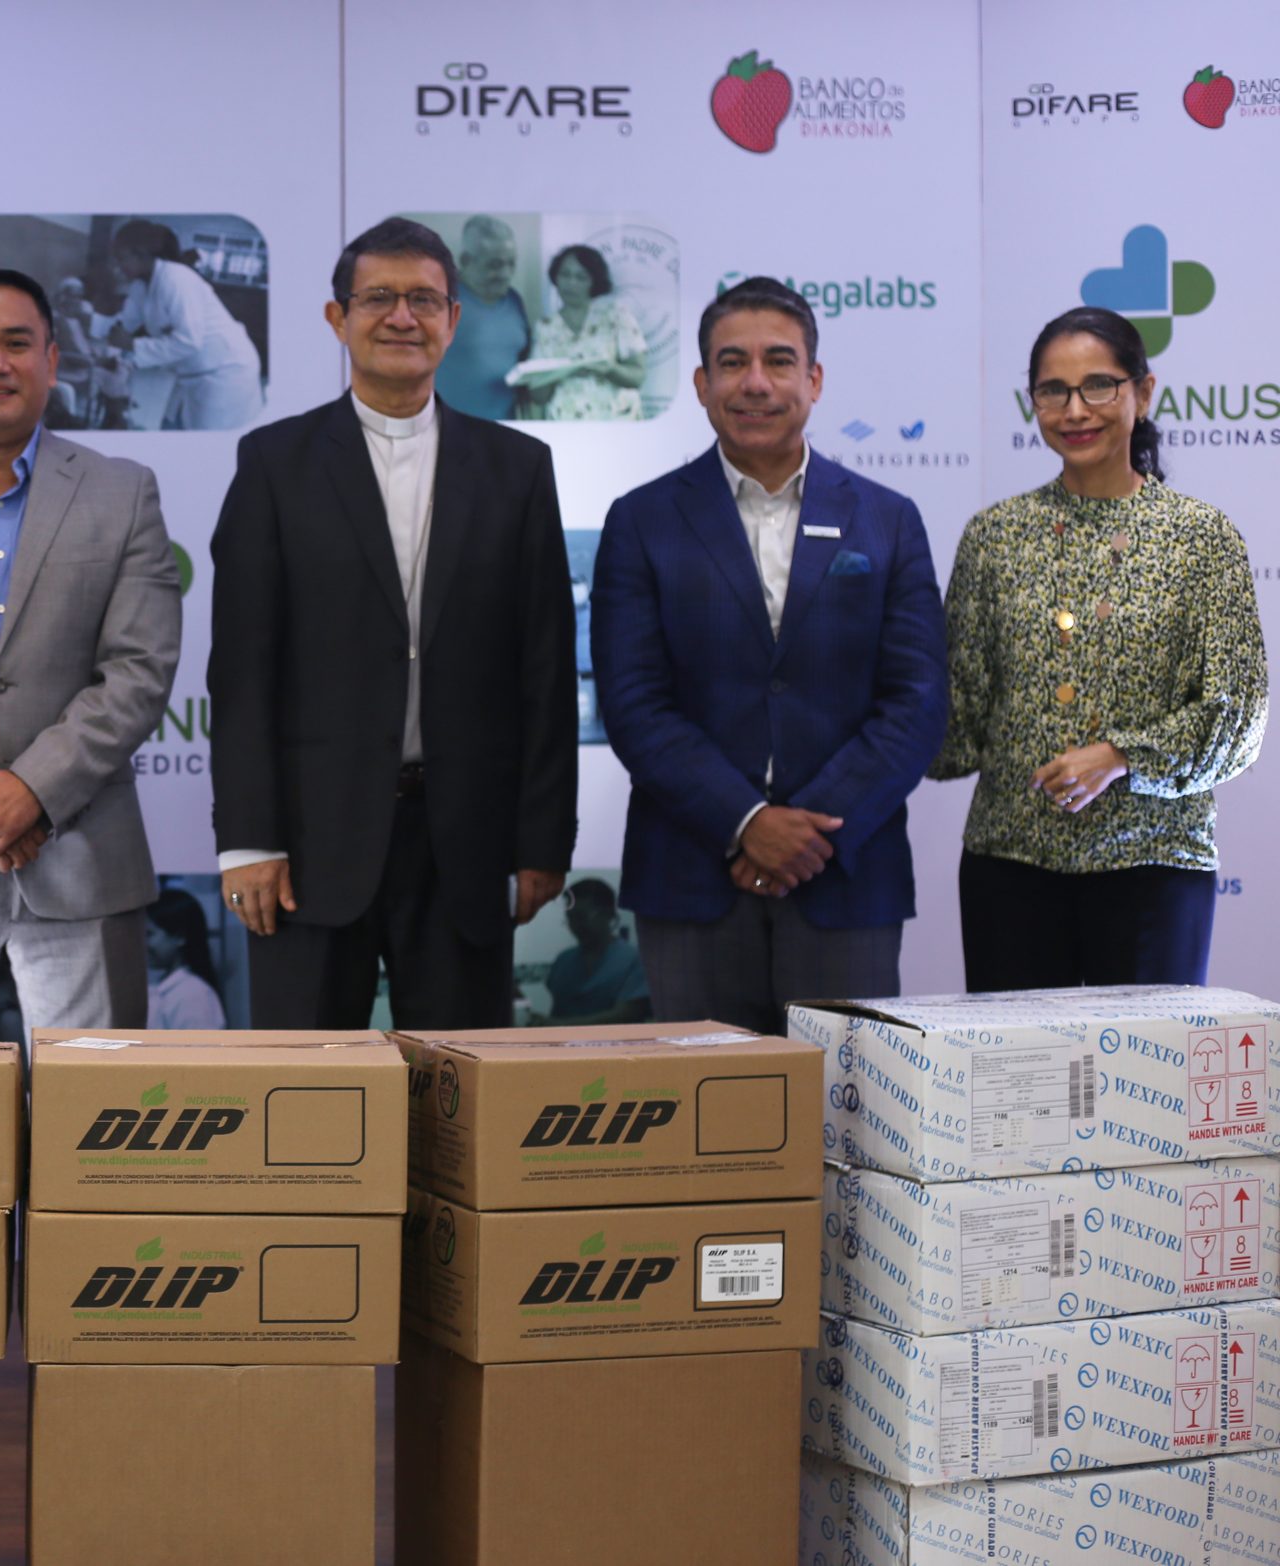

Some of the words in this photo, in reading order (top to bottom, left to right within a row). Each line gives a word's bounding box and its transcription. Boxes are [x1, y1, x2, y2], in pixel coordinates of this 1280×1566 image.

[799, 76, 886, 100] BANCO
[1235, 92, 1280, 107] ALIMEN
[1238, 79, 1280, 94] BANC
[416, 86, 631, 118] DIFARE
[793, 101, 906, 121] ALIMENTOS
[1012, 92, 1139, 117] DIFARE
[1240, 106, 1280, 117] DIAKO
[416, 122, 632, 137] GRUPO
[856, 453, 971, 468] SIEGFRIED
[869, 1019, 931, 1073] WEXFORD
[1127, 1034, 1185, 1068] WEXFO
[622, 1088, 680, 1100] INDUSTRIAL
[857, 1053, 919, 1114] WEXFORD
[1115, 1077, 1186, 1116] WEXFOR
[1241, 1081, 1252, 1100] 8
[184, 1096, 248, 1106] INDUSTRIAL
[75, 1108, 246, 1151] DLIP
[520, 1099, 679, 1148] DLIP
[1189, 1127, 1220, 1141] HANDLE
[1222, 1125, 1243, 1137] WITH
[1244, 1122, 1266, 1135] CARE
[1102, 1120, 1184, 1160] WEXFORD
[1122, 1170, 1183, 1207] WEXFO
[180, 1250, 244, 1261] INDUSTRIAL
[621, 1240, 680, 1253] INDUSTRIAL
[1236, 1235, 1246, 1254] 8
[70, 1266, 240, 1309] DLIP
[518, 1256, 677, 1306] DLIP
[1098, 1256, 1176, 1296] WEXFORD
[1184, 1280, 1215, 1294] HANDLE
[1216, 1279, 1236, 1290] WITH
[1237, 1276, 1259, 1288] CARE
[1118, 1326, 1173, 1361] WEXFO
[1220, 1332, 1228, 1350] CON
[842, 1334, 905, 1400] WEXFORD
[1220, 1353, 1228, 1381] ABRIR
[971, 1375, 979, 1394] CON
[1106, 1368, 1172, 1406] WEXFOR
[1229, 1388, 1239, 1408] 8
[971, 1396, 979, 1425] ABRIR
[1220, 1383, 1228, 1430] APLASTAR
[970, 1428, 979, 1475] APLASTAR
[1173, 1433, 1205, 1447] HANDLE
[1230, 1429, 1252, 1442] CARE
[1220, 1435, 1228, 1447] NO
[1208, 1461, 1216, 1479] CON
[988, 1497, 997, 1516] CON
[1118, 1488, 1199, 1530] WEXFORD
[1206, 1481, 1216, 1521] CUIDADO
[912, 1515, 1050, 1566] LABORAORIES
[987, 1517, 997, 1558] CUIDADO
[1104, 1530, 1186, 1566] WEXFORD
